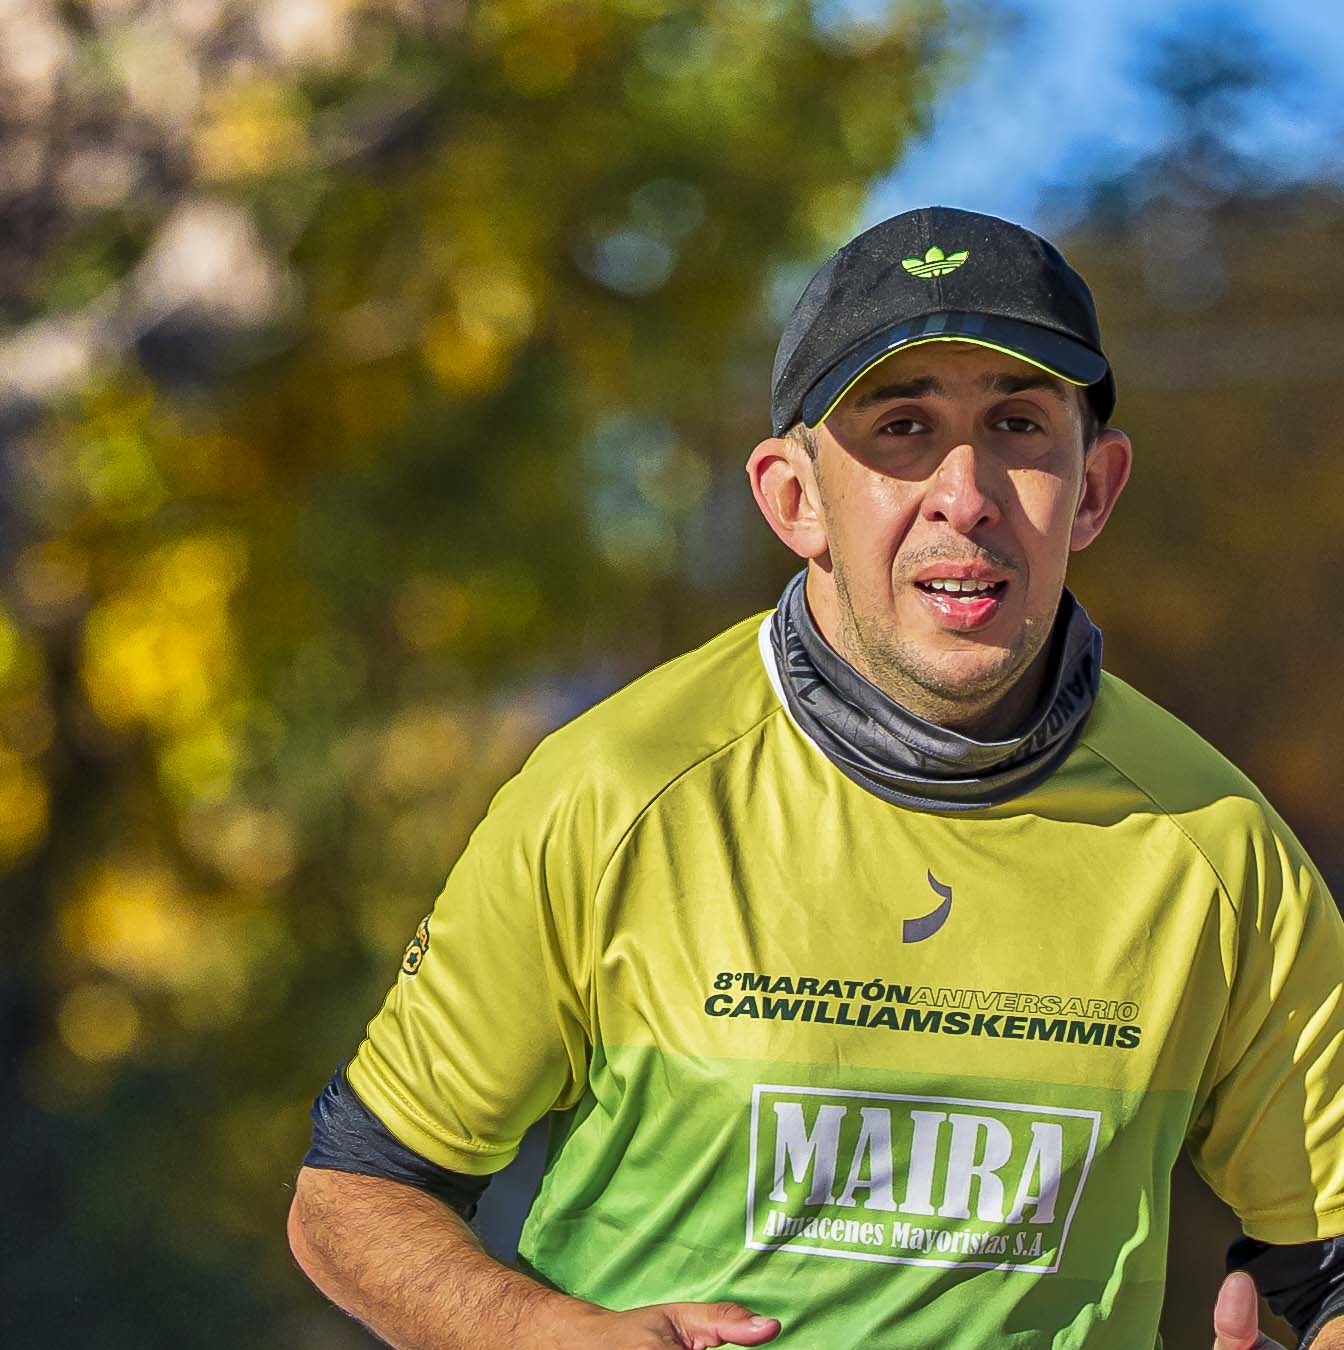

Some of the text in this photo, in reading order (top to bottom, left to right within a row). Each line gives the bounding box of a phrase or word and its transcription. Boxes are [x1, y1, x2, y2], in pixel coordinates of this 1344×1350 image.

[704, 993, 1143, 1049] CAWILLIAMSKEMMIS
[909, 986, 1140, 1023] ANIVERSARIO
[769, 1101, 1063, 1224] MAIRA
[762, 1210, 885, 1247] Almacenes
[891, 1221, 1010, 1256] Mayoristas
